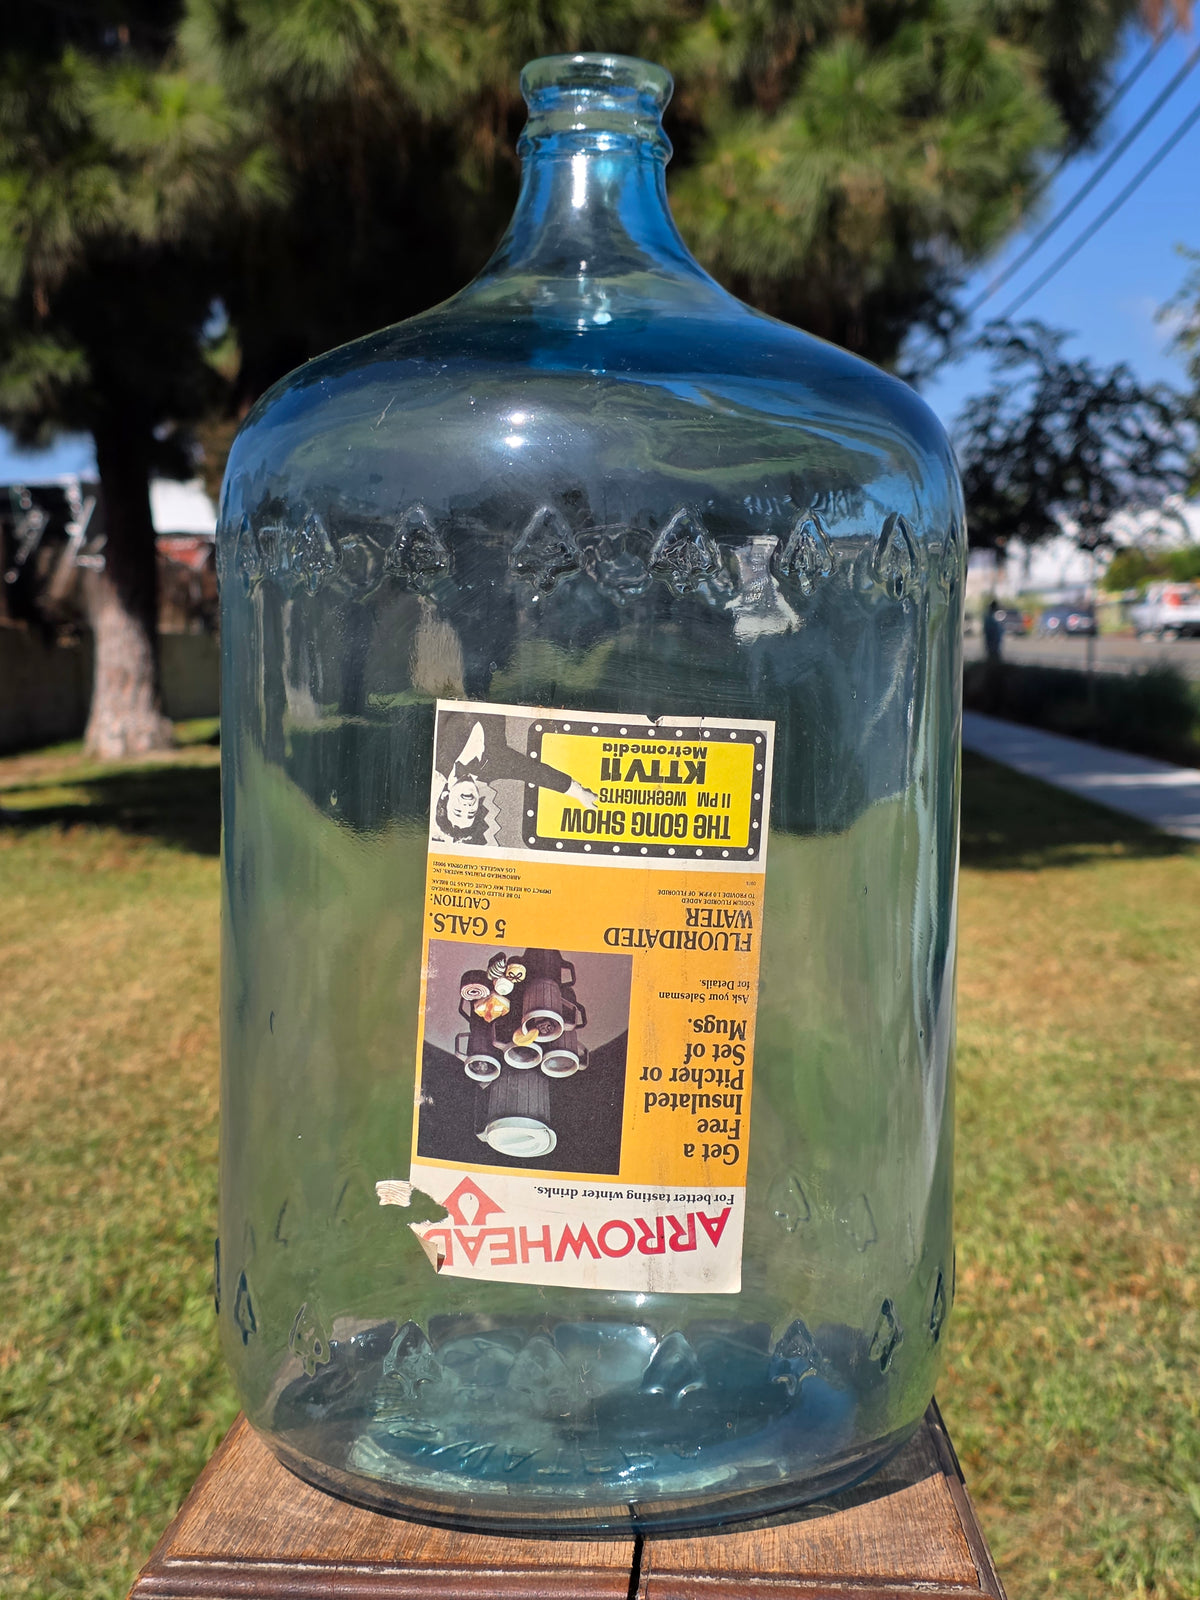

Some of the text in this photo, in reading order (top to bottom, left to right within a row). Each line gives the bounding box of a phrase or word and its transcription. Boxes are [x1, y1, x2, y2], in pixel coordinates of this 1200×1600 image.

[602, 743, 707, 759] Metromedia
[697, 792, 718, 808] PM
[722, 793, 731, 808] 11
[560, 808, 625, 835] SHOW
[430, 894, 490, 910] CAUTION:
[429, 912, 506, 938] 5 GALS.
[686, 908, 752, 928] WATER
[604, 928, 752, 952] FLUORIDATED
[700, 979, 750, 990] for Details.
[659, 992, 749, 1004] Ask your Salesman
[688, 1015, 747, 1041] Mugs.
[684, 1044, 746, 1066] Set of
[640, 1067, 744, 1090] Pitcher or
[644, 1092, 743, 1115] Insulated
[697, 1119, 741, 1139] Free
[684, 1144, 740, 1165] Get a
[534, 1186, 734, 1205] For better tasting winter drinks.
